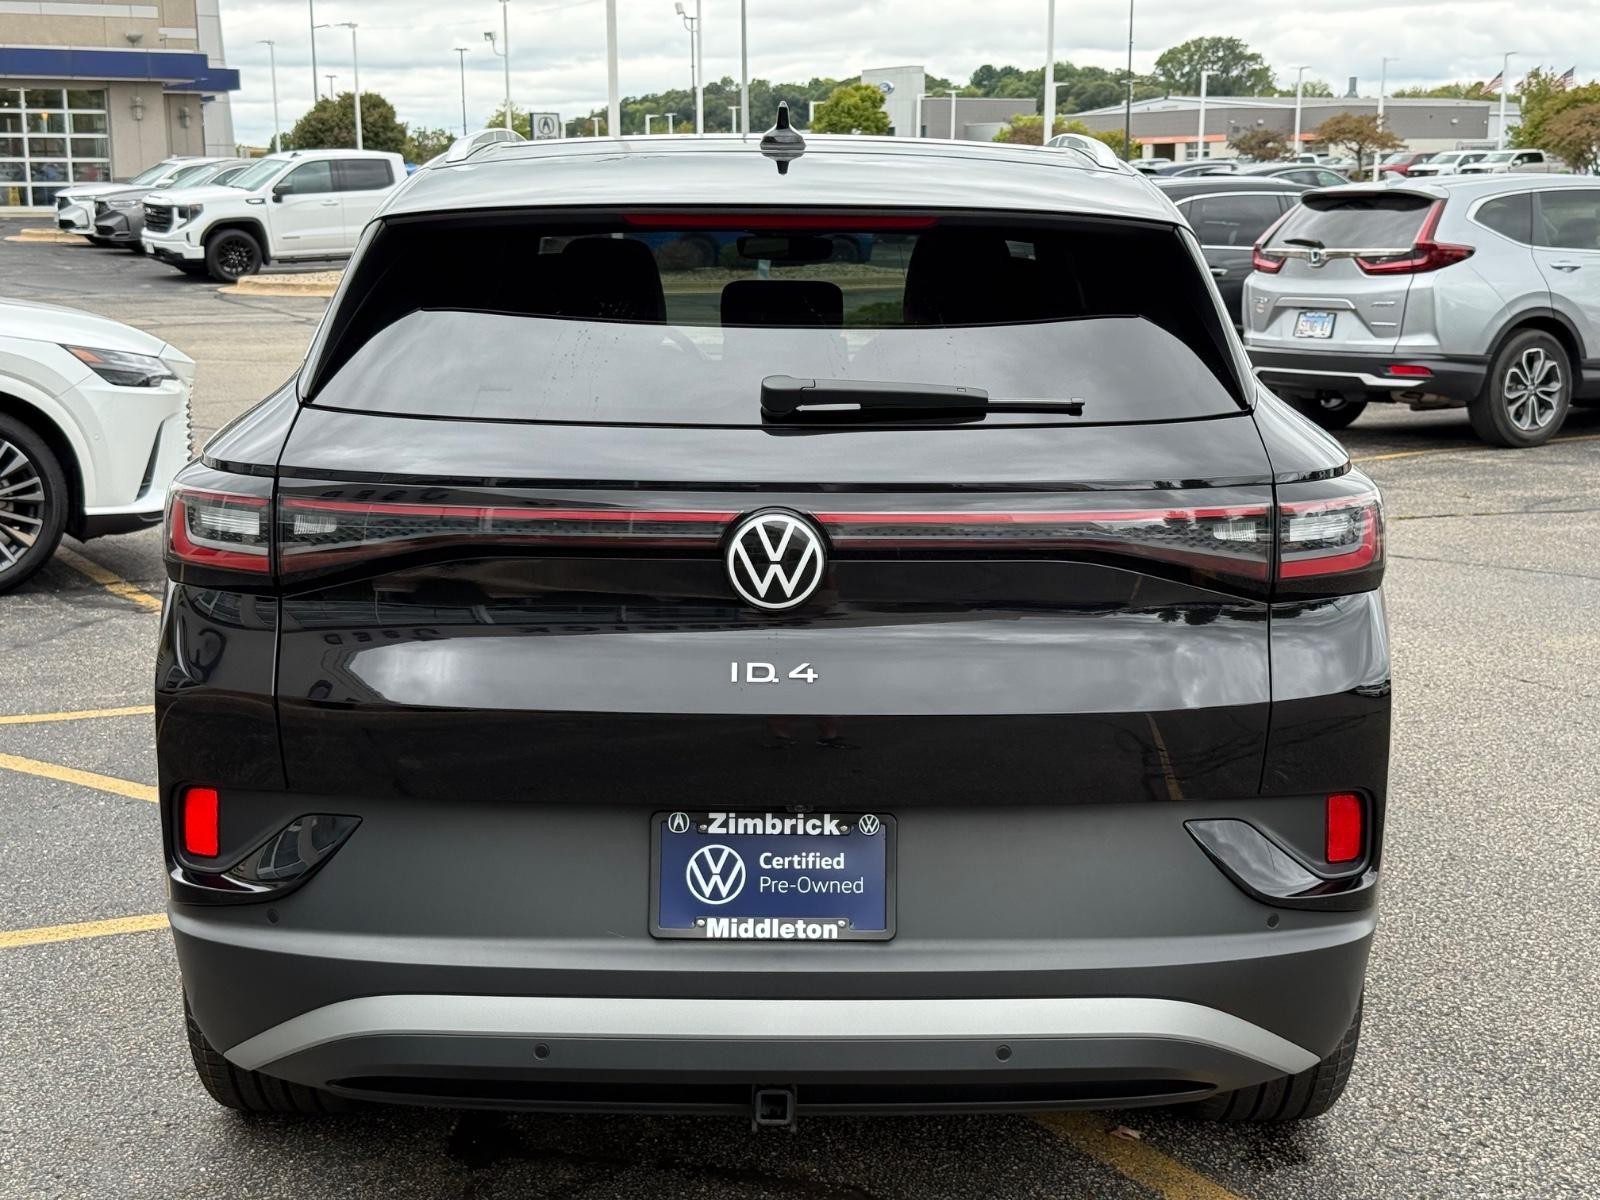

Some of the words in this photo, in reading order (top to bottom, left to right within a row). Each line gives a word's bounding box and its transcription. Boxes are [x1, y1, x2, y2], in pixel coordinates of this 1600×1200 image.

[729, 514, 824, 608] VW
[708, 812, 840, 836] Zimbrick
[759, 852, 845, 870] Certified
[686, 844, 746, 905] VW
[759, 876, 864, 894] Pre-Owned
[706, 917, 839, 939] Middleton
